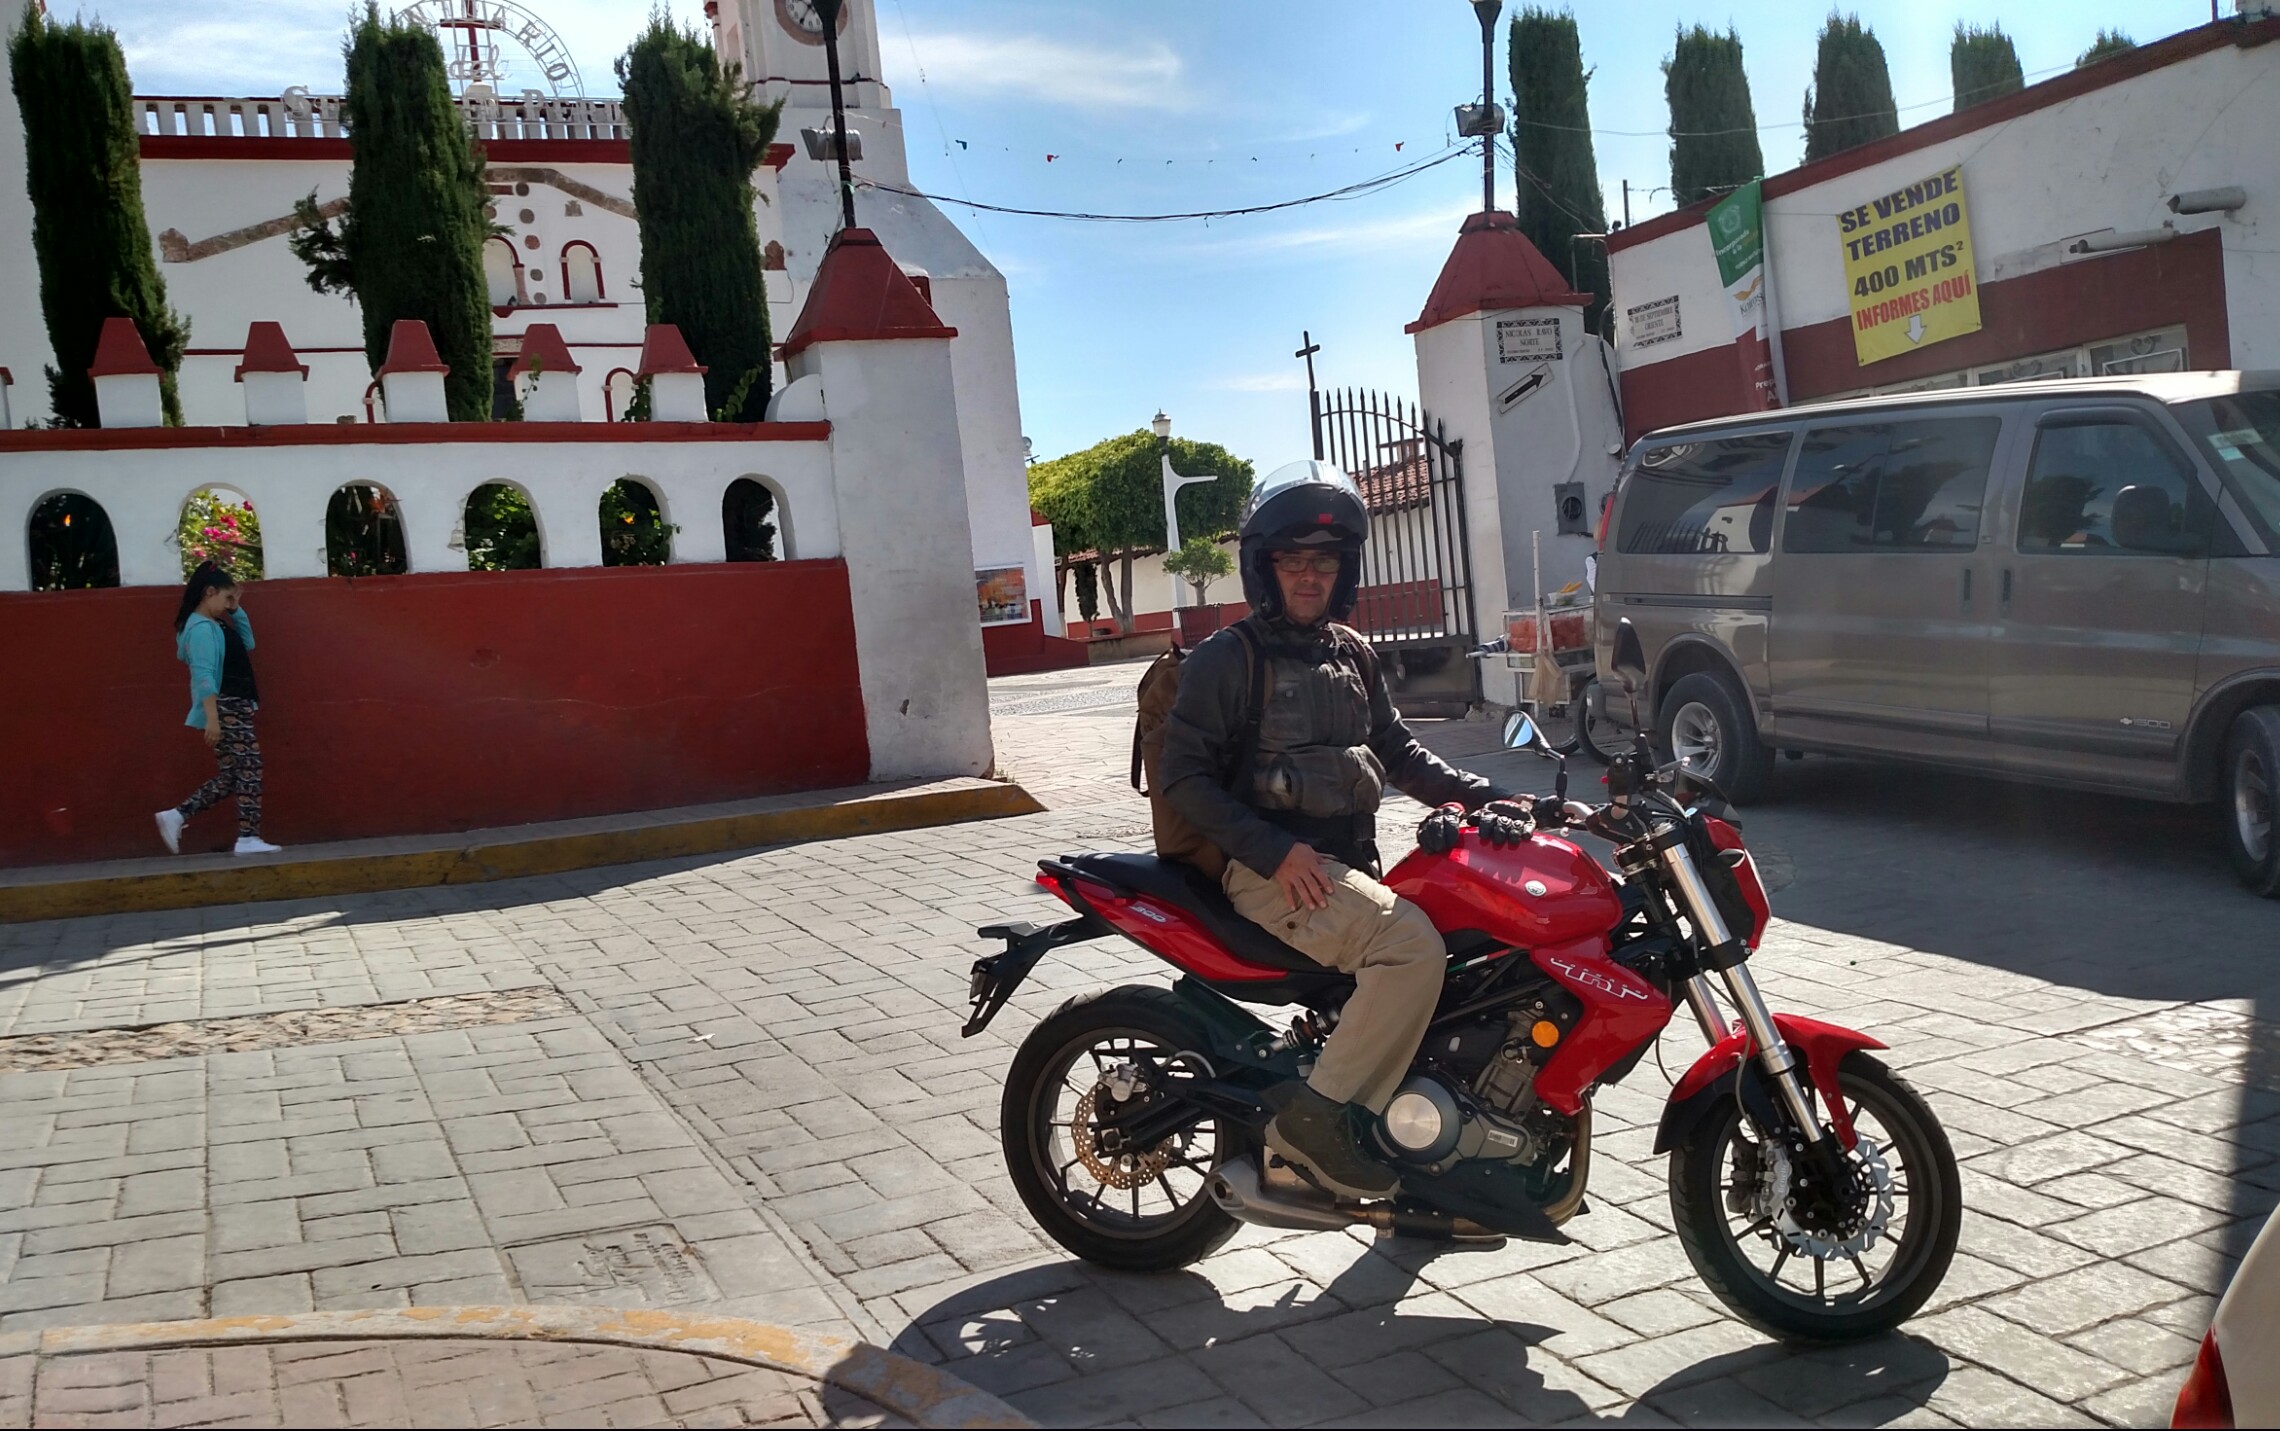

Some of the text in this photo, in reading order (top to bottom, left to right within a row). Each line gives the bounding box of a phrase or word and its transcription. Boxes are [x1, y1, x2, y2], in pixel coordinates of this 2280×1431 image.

[1840, 169, 1959, 233] SE VENDE
[1846, 202, 1961, 262] TERRENO
[1854, 265, 1900, 297] 400
[1856, 269, 1972, 331] INFORMES AQUÍ
[1519, 338, 1540, 346] NORTE
